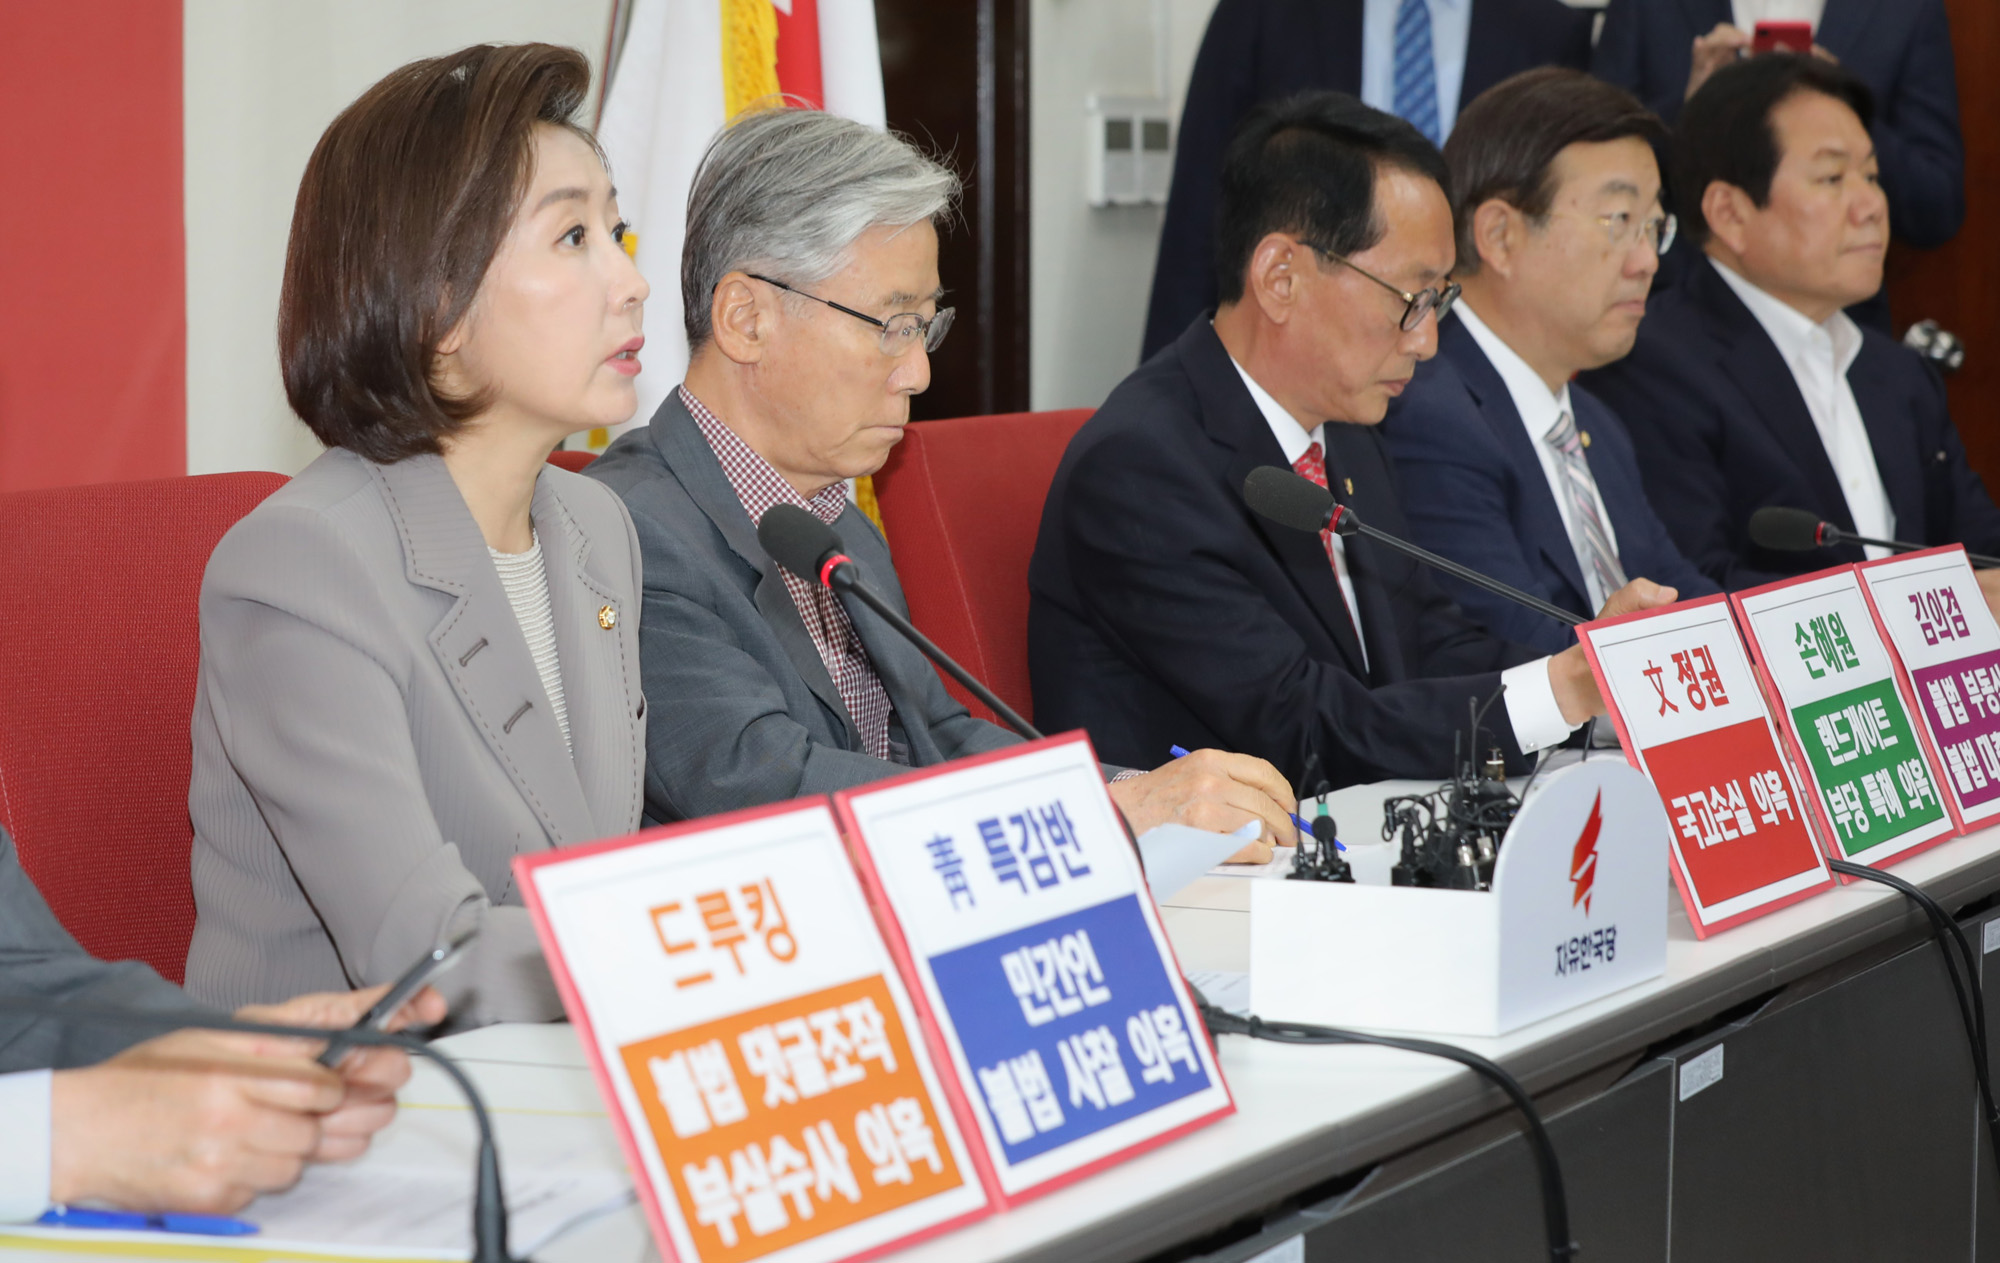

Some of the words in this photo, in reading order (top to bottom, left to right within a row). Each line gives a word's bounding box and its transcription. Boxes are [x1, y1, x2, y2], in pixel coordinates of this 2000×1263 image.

[1795, 612, 1860, 680] 손혜원
[1908, 586, 1970, 646] 김의겸
[1642, 659, 1679, 718] 文
[1671, 644, 1730, 711] 정권
[1926, 675, 1970, 729] 불법
[1671, 779, 1757, 849] 국고손실
[1749, 769, 1795, 825] 의혹
[1826, 780, 1870, 839] 부당
[1860, 768, 1906, 823] 특혜
[1897, 758, 1936, 810] 의혹
[976, 799, 1091, 896] 특감반
[648, 877, 798, 989] 드루킹
[1555, 925, 1617, 976] 자유한국당
[1000, 929, 1112, 1027] 민간인
[648, 1039, 748, 1138] 불법
[738, 997, 897, 1109] 댓글조작
[978, 1050, 1066, 1145] 불법
[1057, 1025, 1136, 1110] 사찰
[1126, 1004, 1200, 1085] 의혹
[682, 1120, 862, 1247] 부실수사
[855, 1097, 943, 1185] 의혹
